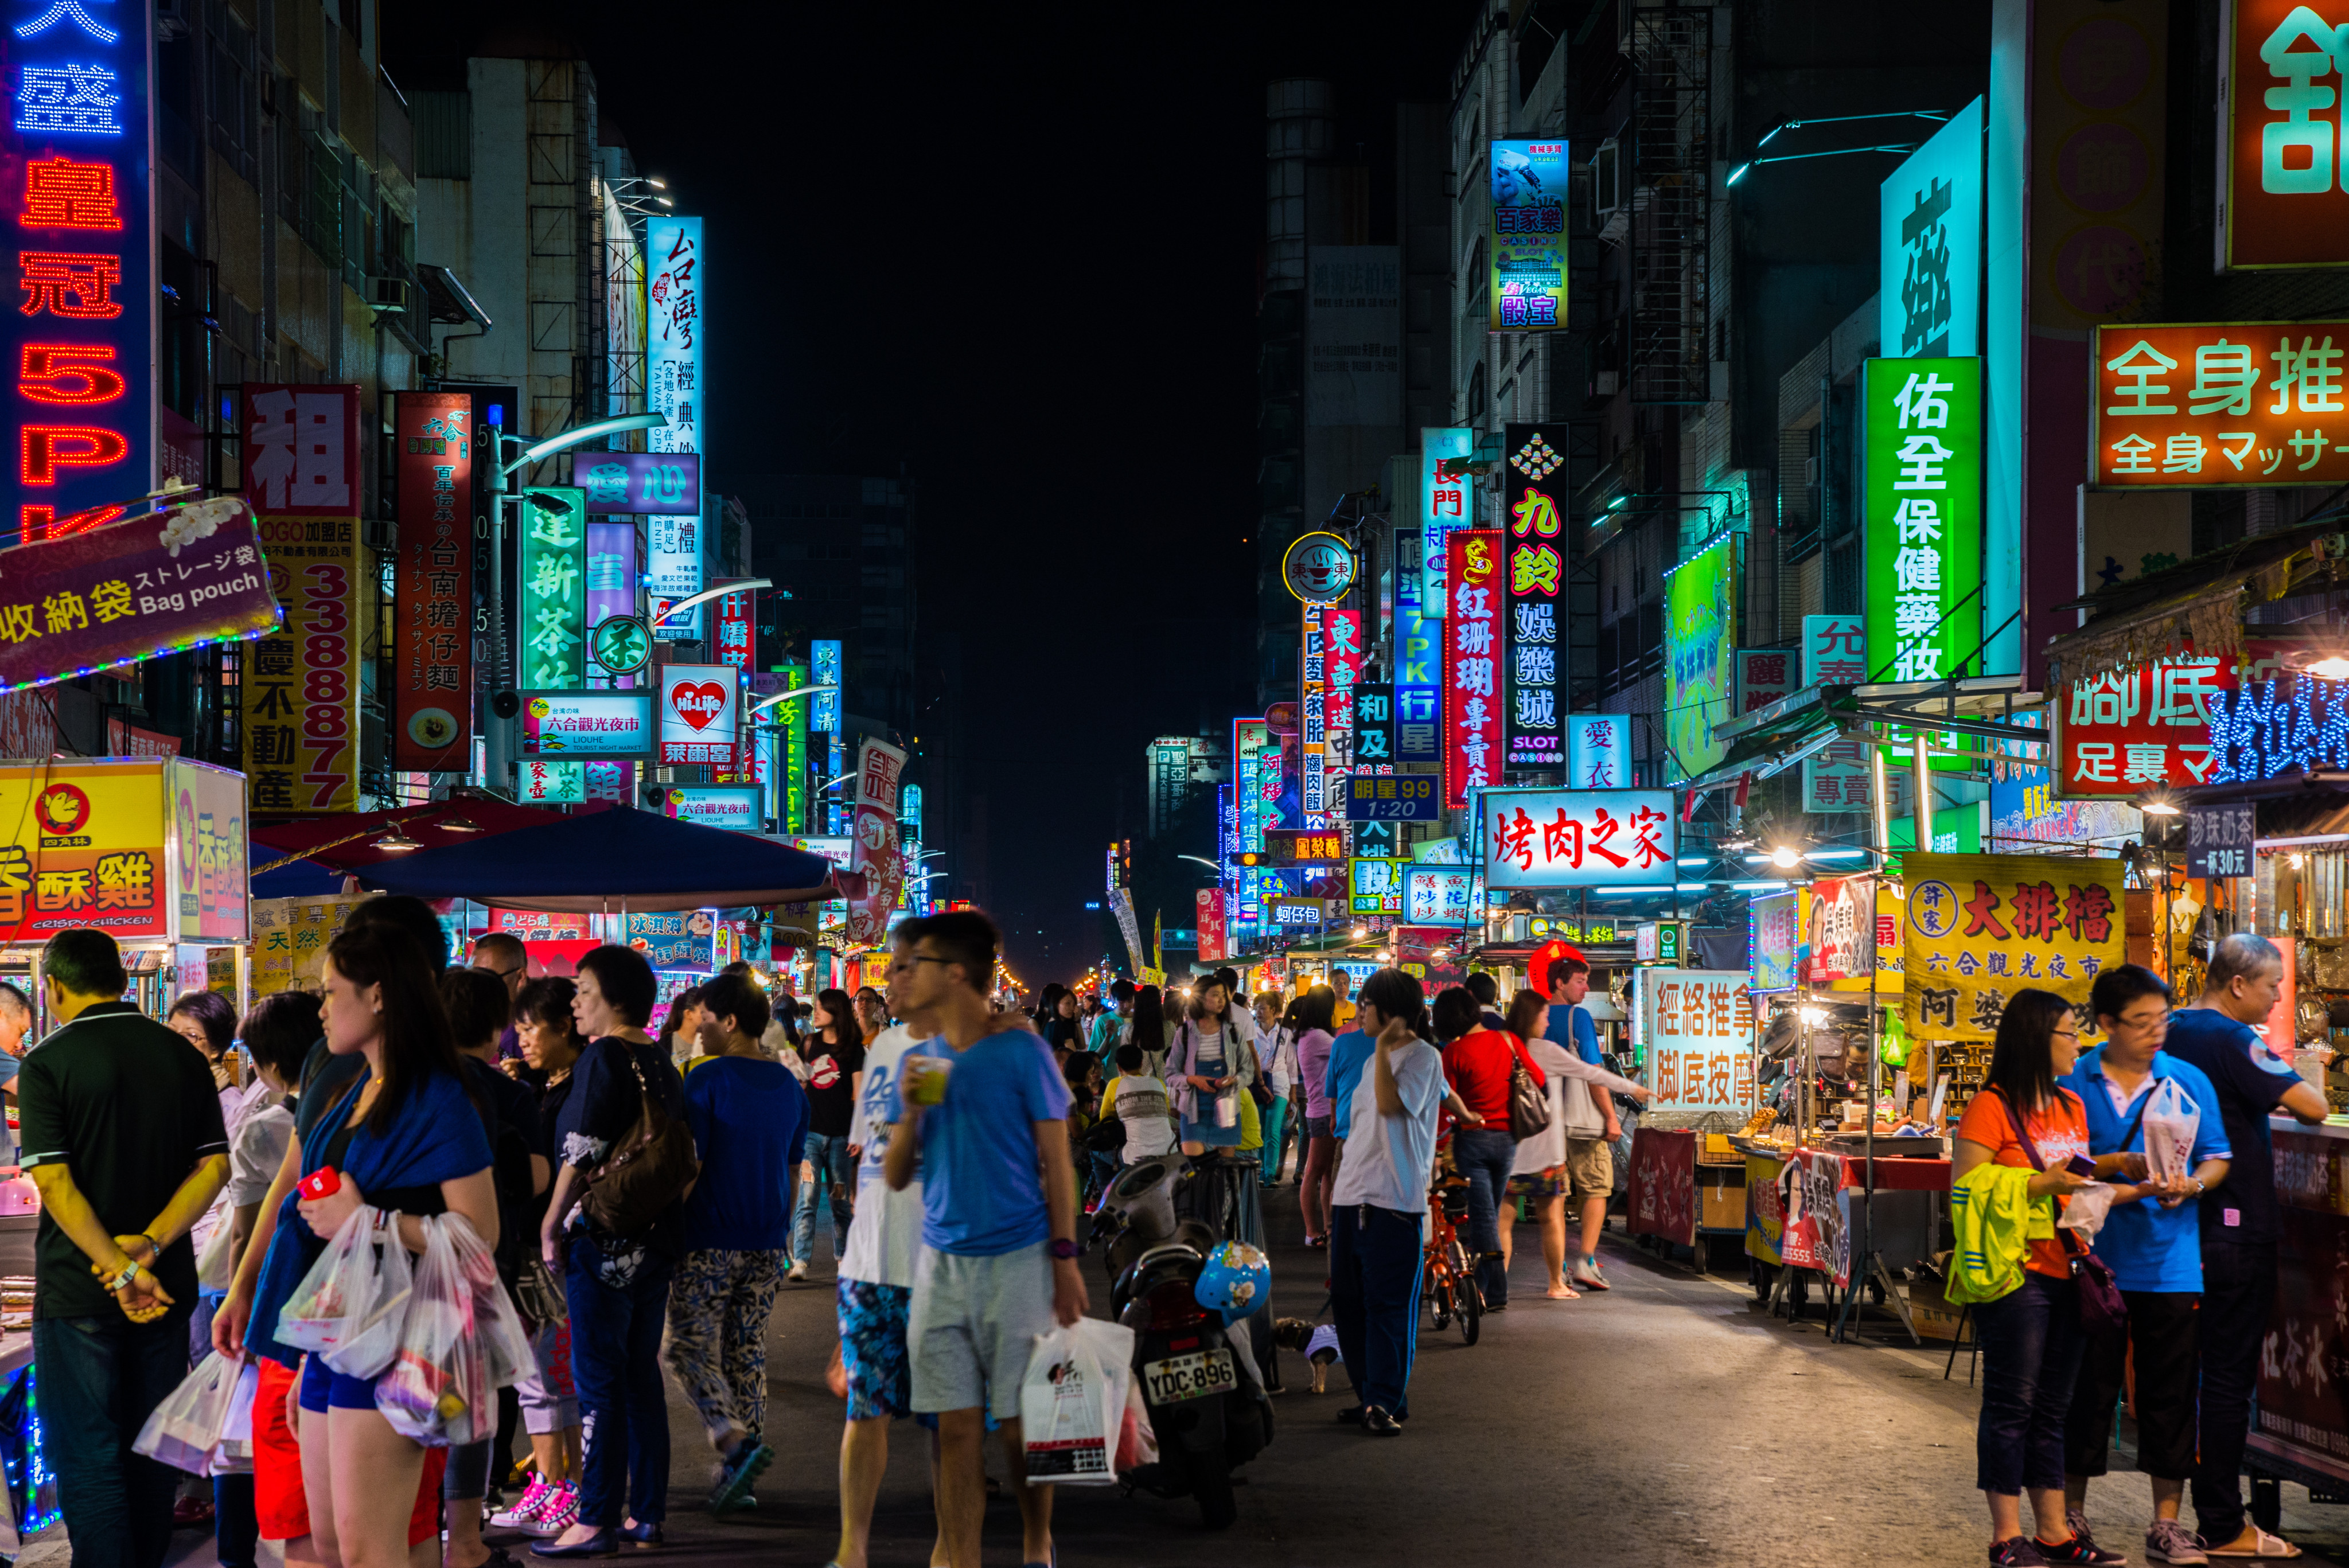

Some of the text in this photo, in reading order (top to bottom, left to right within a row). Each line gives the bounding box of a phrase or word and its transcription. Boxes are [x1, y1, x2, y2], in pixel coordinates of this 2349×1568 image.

[1495, 206, 1563, 233] 百家樂
[1500, 236, 1557, 246] CASINO
[663, 228, 698, 350] 台灣
[422, 418, 467, 442] 六合
[251, 390, 349, 509] 租
[586, 462, 687, 504] 愛心
[135, 545, 256, 591] ストレージ袋
[1292, 563, 1349, 579] 東 東
[139, 572, 259, 616] Bag pouch
[251, 599, 295, 809] 慶不動產
[677, 692, 721, 718] Hi-Life
[547, 717, 640, 732] 六合觀光夜市
[665, 744, 731, 763] 萊爾富
[1513, 736, 1559, 749] SLOT
[1509, 752, 1564, 763] CASINO
[1354, 779, 1431, 799] 明星99
[682, 804, 750, 814] 六合觀光夜市
[1368, 801, 1416, 817] 1:20
[1494, 805, 1673, 872] 烤肉之家
[2190, 808, 2252, 847] 珍珠奶茶
[1275, 905, 1319, 923] 蚵仔包
[1922, 886, 1945, 933] 許家
[1964, 880, 2116, 944] 大排檔
[32, 916, 154, 930] CRISPY CHICKEN
[1926, 951, 2102, 981] 六合觀光夜市
[1920, 987, 2098, 1036] 阿婆味
